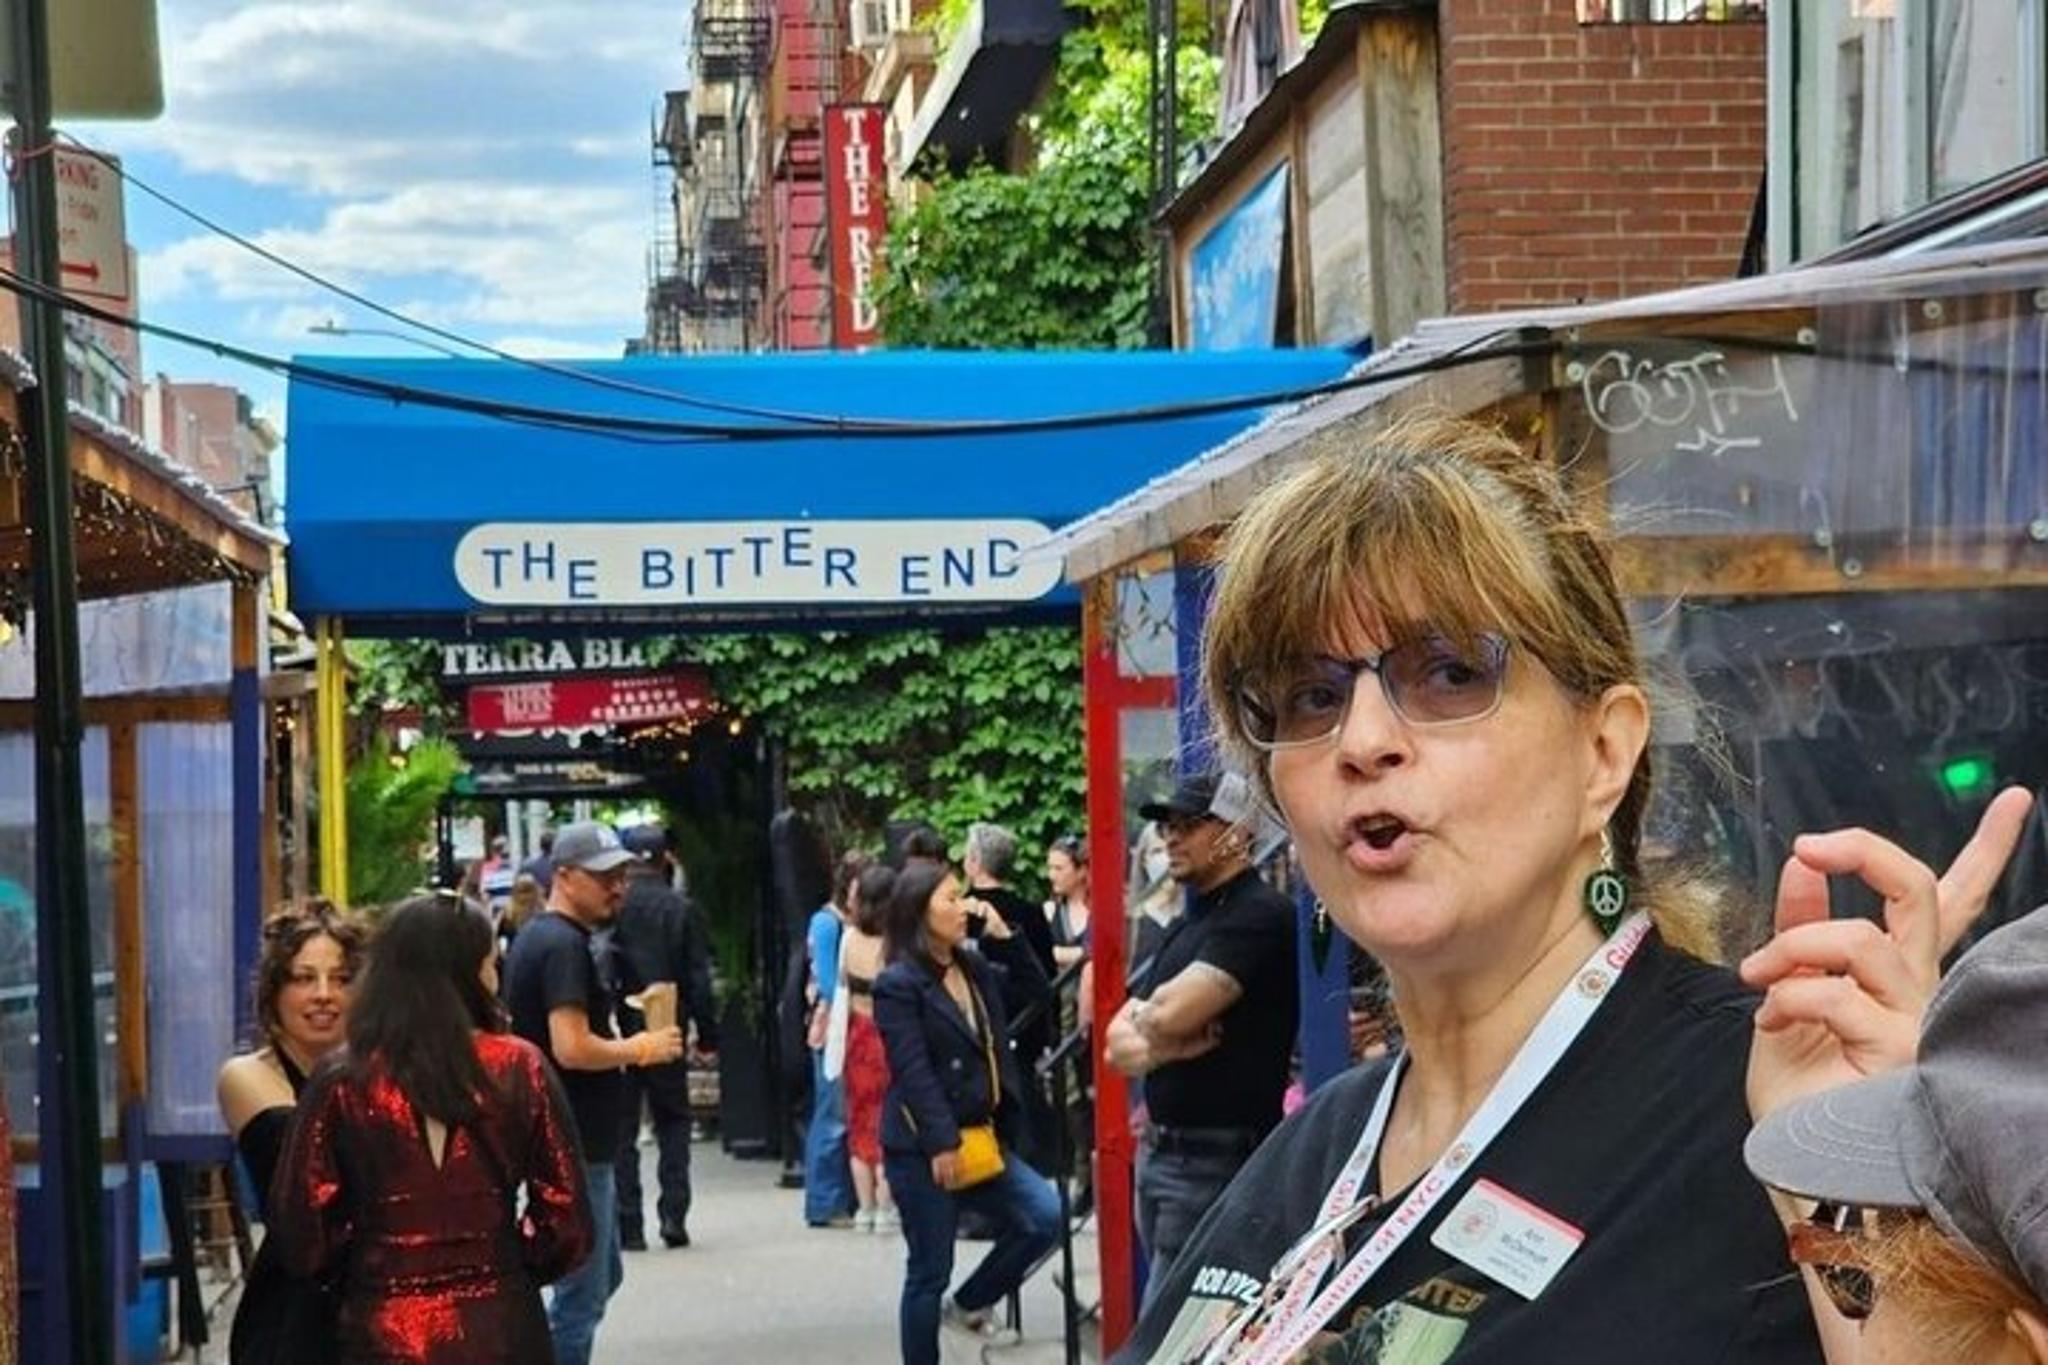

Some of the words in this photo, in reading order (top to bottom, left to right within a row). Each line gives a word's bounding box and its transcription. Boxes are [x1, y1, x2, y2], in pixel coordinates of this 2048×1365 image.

[842, 107, 870, 216] THE
[849, 225, 877, 332] RED
[482, 541, 598, 599] THE
[642, 528, 857, 596] BITTER
[901, 538, 1020, 595] END
[438, 640, 577, 675] TERRA
[1395, 1175, 1446, 1227] NYC
